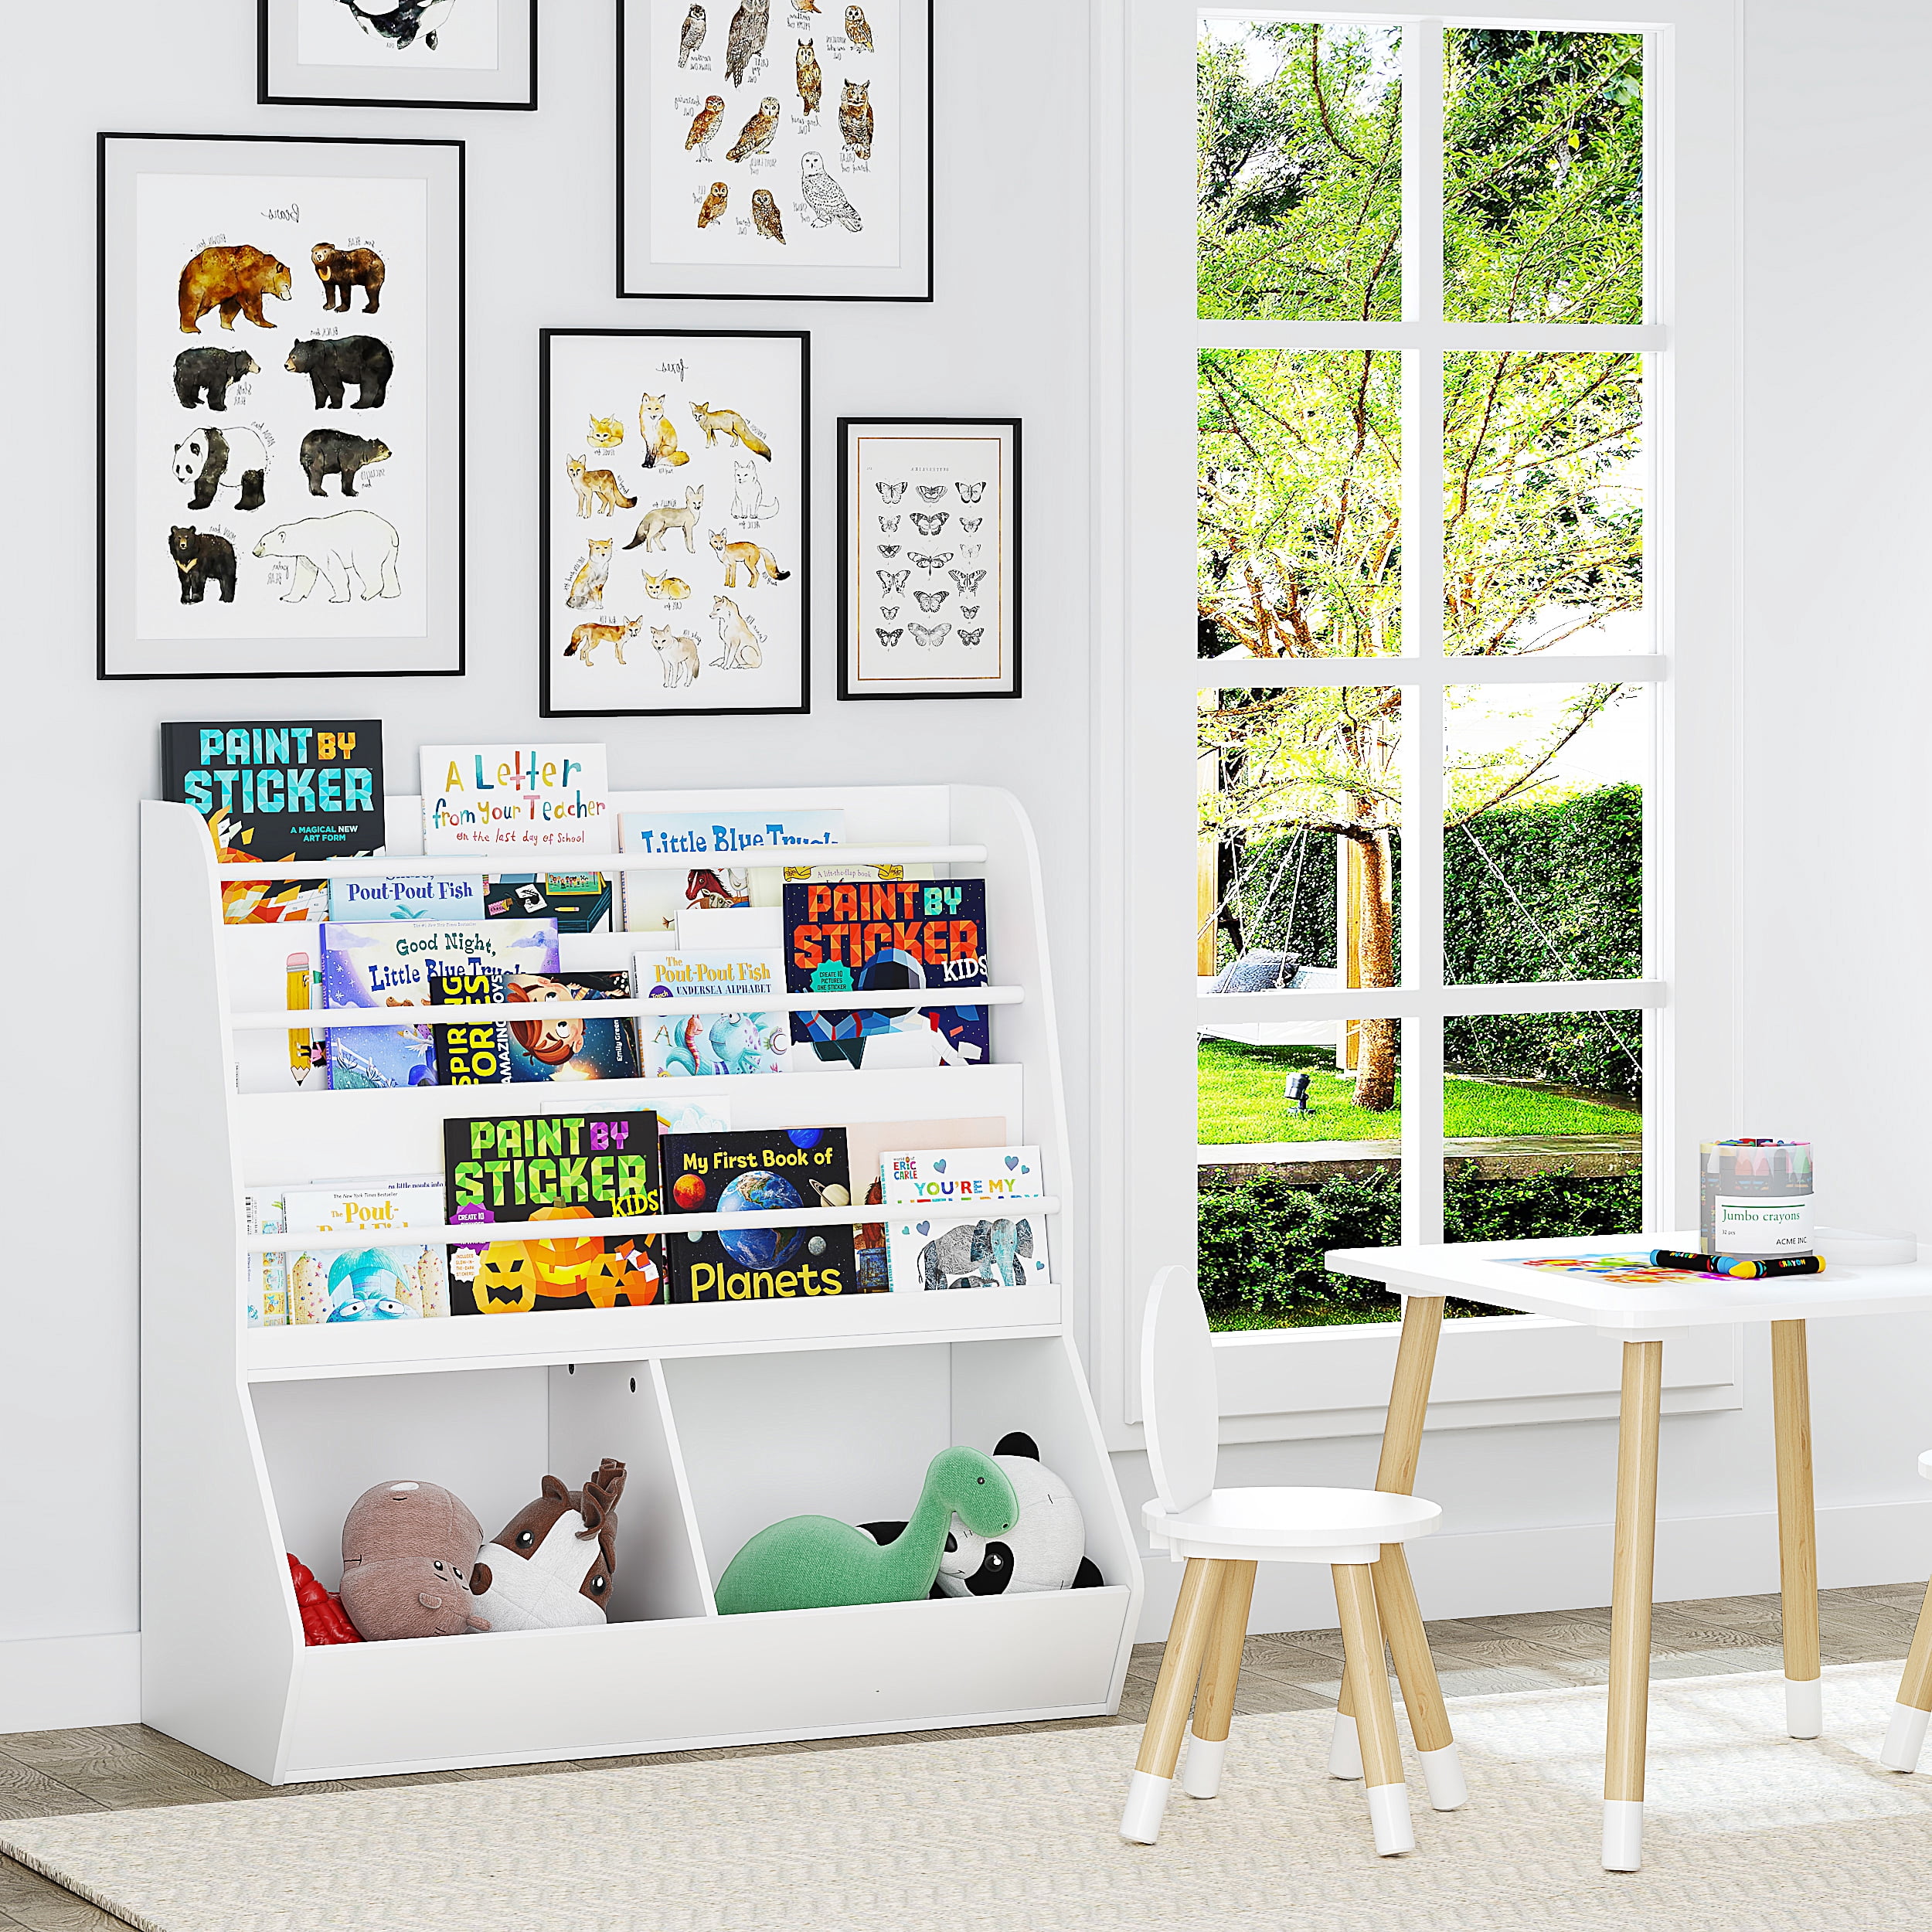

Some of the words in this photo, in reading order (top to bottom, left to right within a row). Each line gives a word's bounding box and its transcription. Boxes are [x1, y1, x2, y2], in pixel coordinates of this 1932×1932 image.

[199, 727, 313, 766] PAINT
[317, 732, 356, 760] BY
[445, 760, 464, 792] A
[474, 750, 582, 791] Letter
[184, 767, 375, 814] STICKER
[432, 798, 476, 829] from
[523, 790, 606, 821] Teacher
[456, 831, 469, 841] on
[472, 831, 490, 842] the
[495, 828, 516, 842] last
[522, 831, 539, 846] day
[543, 832, 554, 845] of
[641, 830, 707, 854] Little
[712, 825, 764, 852] Blue
[824, 869, 856, 879] lift-the-flap
[858, 869, 871, 878] book
[346, 883, 435, 902] Pout-Pout
[437, 881, 474, 900] Fish
[808, 883, 920, 923] PAINT
[923, 886, 962, 916] BY
[396, 934, 438, 956] Good
[444, 932, 497, 957] Night,
[794, 920, 979, 969] STICKER
[368, 963, 421, 992] Little
[424, 957, 466, 977] Blue
[652, 963, 735, 983] Pout-Pout
[736, 961, 771, 981] Fish
[665, 956, 683, 967] The
[941, 954, 988, 982] KIDS
[492, 975, 504, 1003] OYS
[676, 985, 723, 995] UNDERSEA
[725, 984, 772, 994] ALPHABET
[470, 1117, 585, 1159] PAINT
[590, 1121, 629, 1151] BY
[683, 1153, 709, 1175] My
[713, 1151, 758, 1169] First
[762, 1148, 809, 1168] Book
[813, 1147, 834, 1165] of
[894, 1170, 918, 1180] CARLE
[454, 1155, 648, 1206] STICKER
[913, 1180, 984, 1196] YOU'RE
[988, 1179, 1017, 1194] MY
[342, 1200, 400, 1224] Pout-
[609, 1189, 659, 1218] KIDS
[1722, 1209, 1759, 1223] Jumbo
[1763, 1212, 1800, 1224] crayons
[1778, 1259, 1806, 1268] CRAYON
[690, 1262, 843, 1301] Planets
